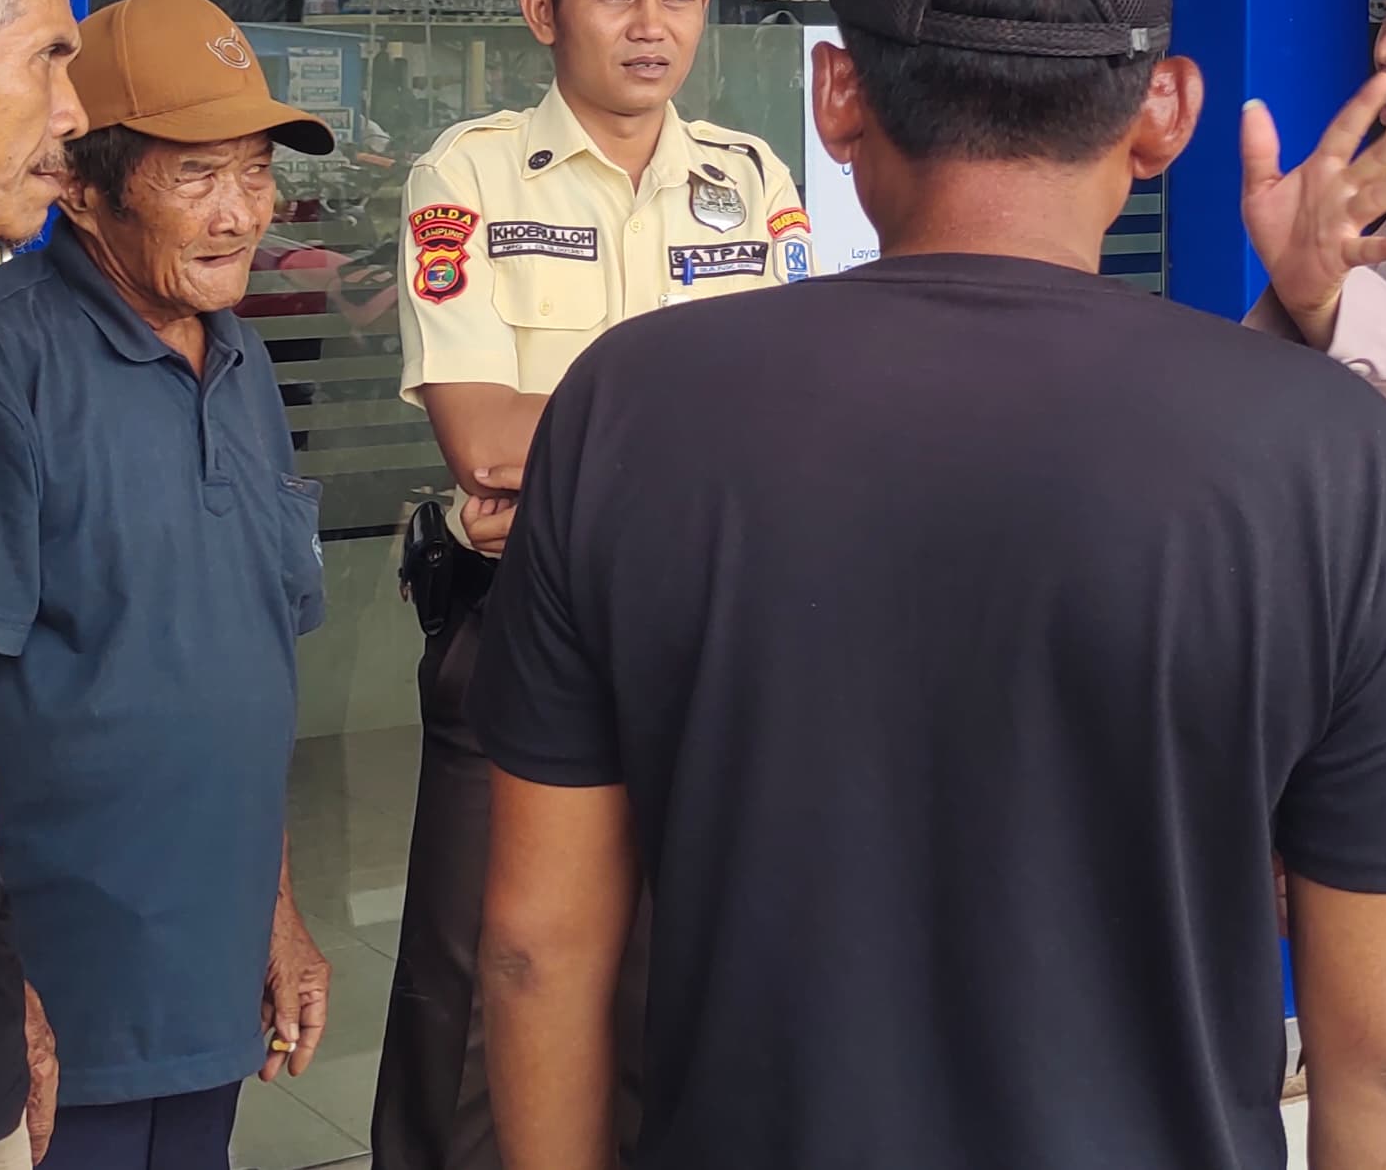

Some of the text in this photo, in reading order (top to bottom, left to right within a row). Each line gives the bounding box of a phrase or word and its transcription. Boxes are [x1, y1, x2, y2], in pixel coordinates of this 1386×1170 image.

[414, 208, 472, 225] POLDA
[419, 228, 465, 239] LAMPUNG
[673, 246, 765, 263] SATPAM
[852, 248, 879, 260] Laya
